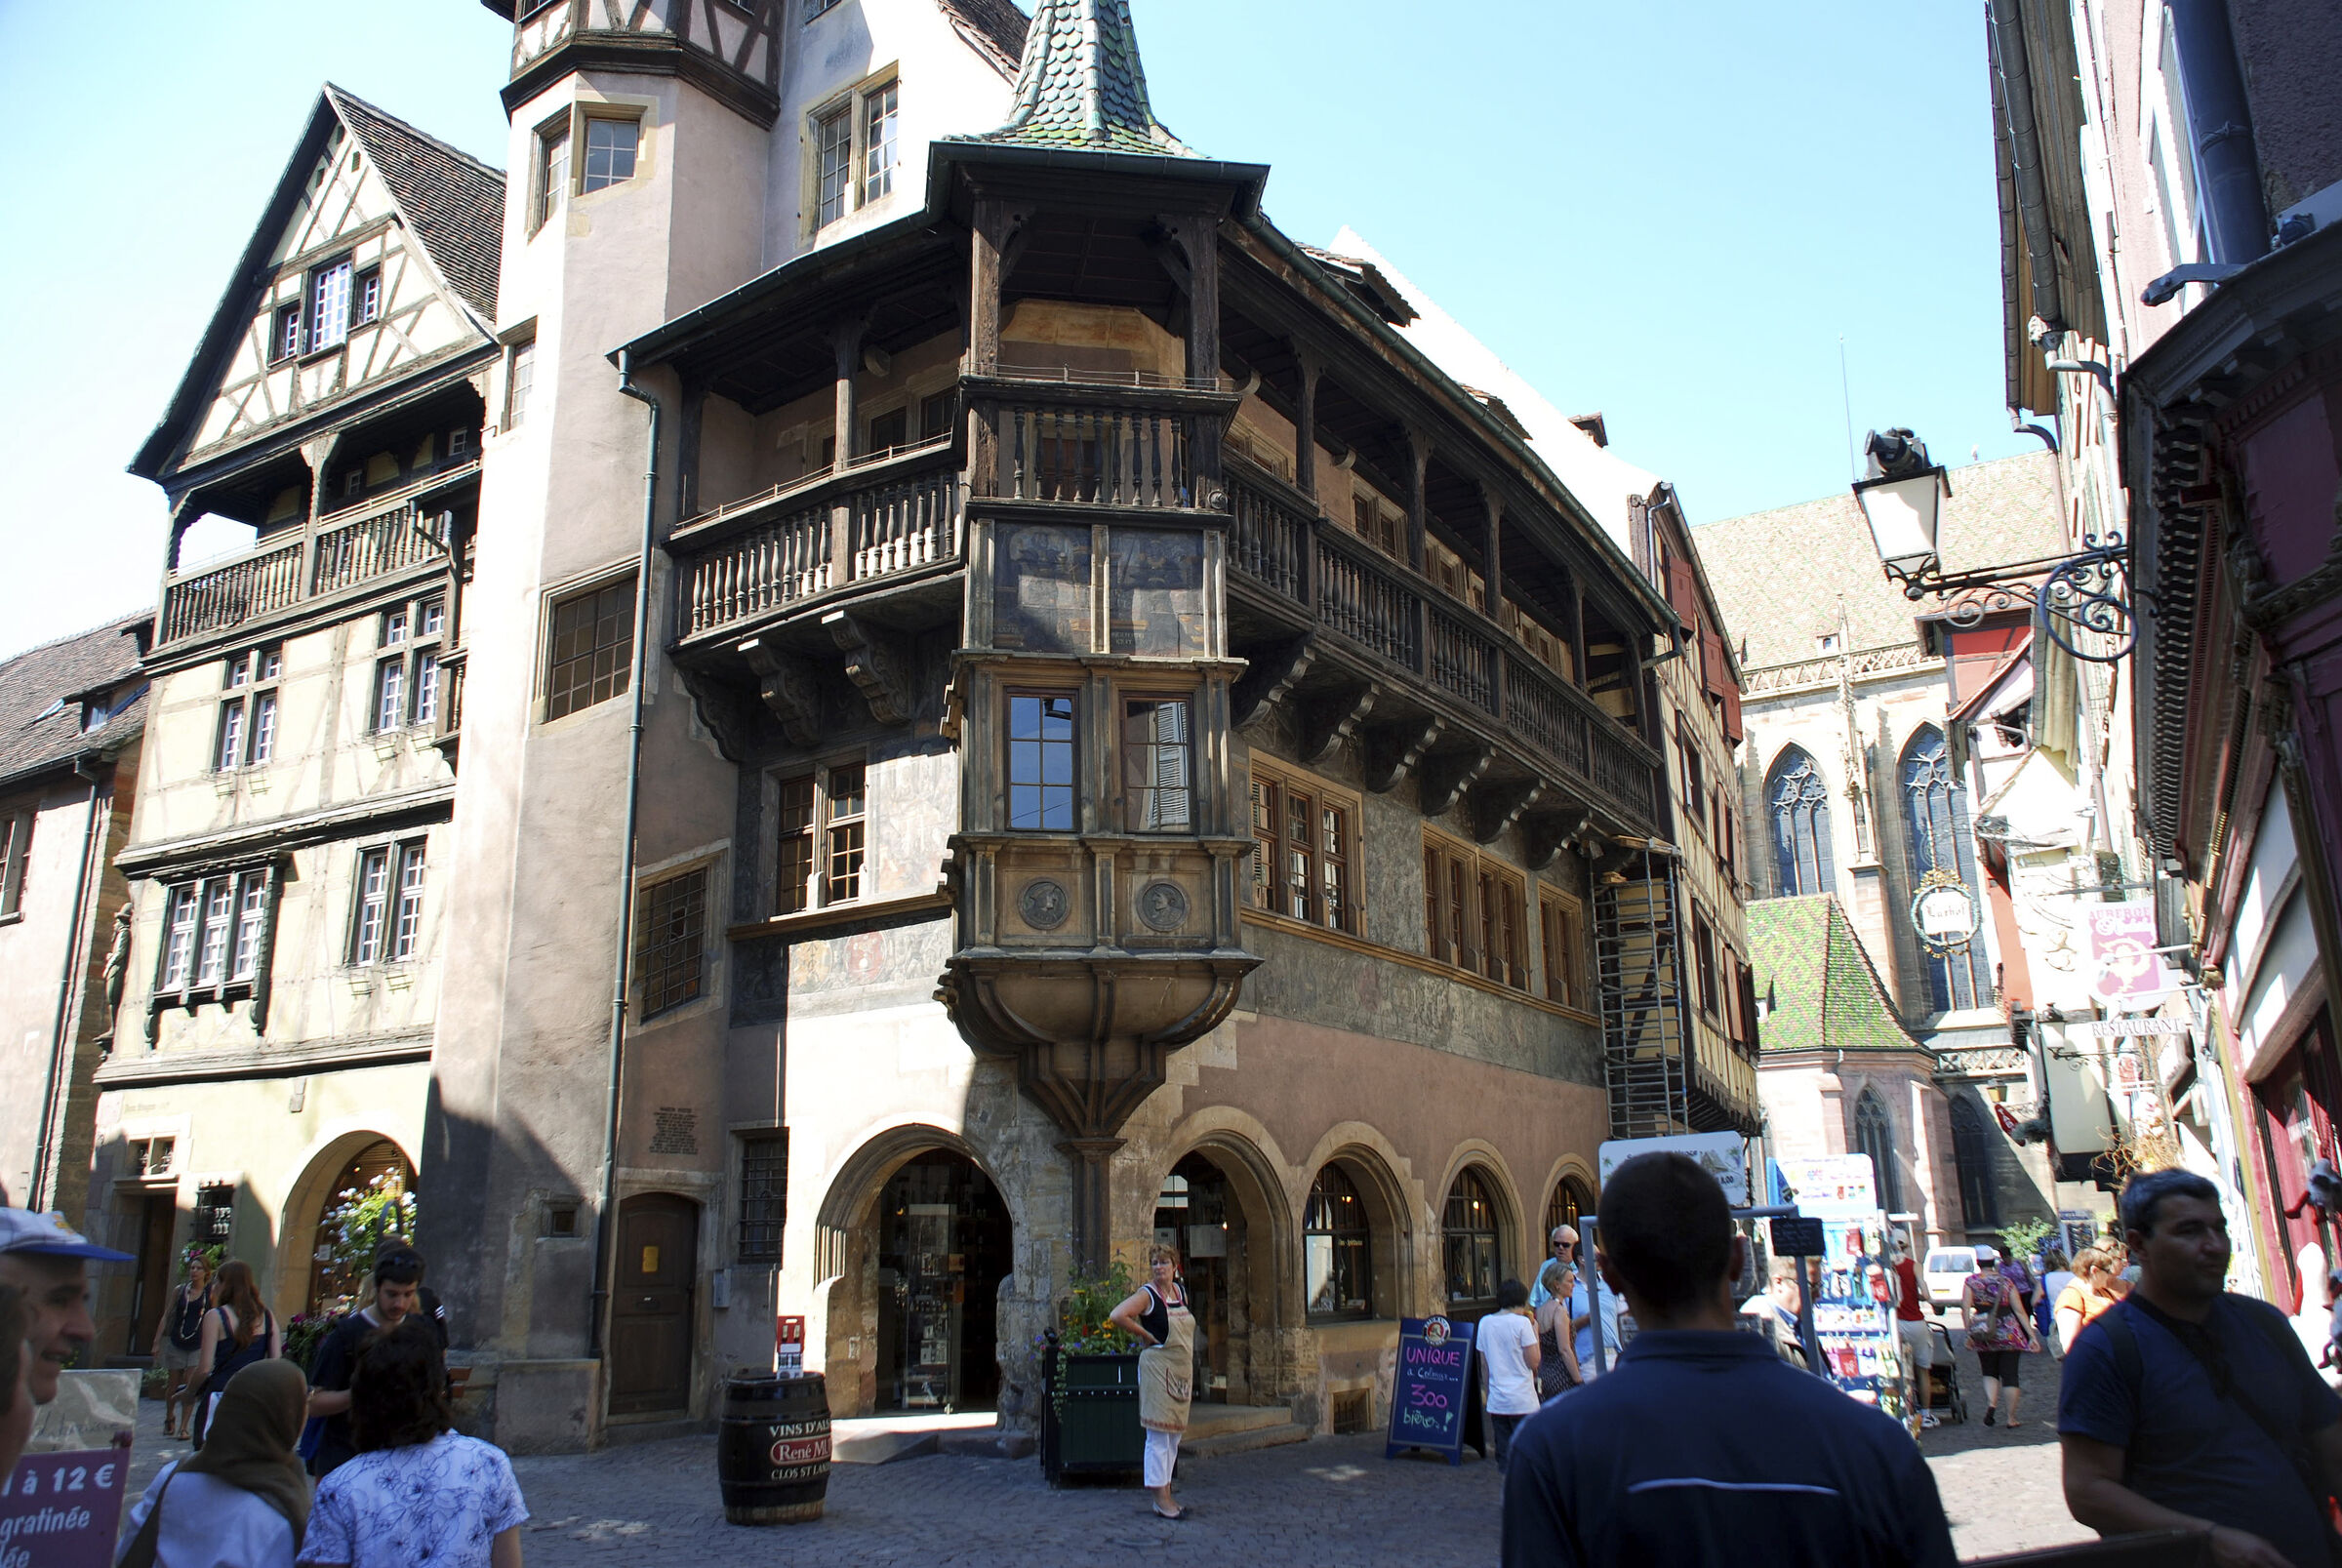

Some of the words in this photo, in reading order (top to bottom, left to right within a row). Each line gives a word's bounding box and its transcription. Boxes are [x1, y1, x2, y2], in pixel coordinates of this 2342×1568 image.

[2091, 1017, 2181, 1038] RESTAURANT
[1411, 1384, 1448, 1409] 300
[769, 1424, 802, 1437] VINS
[779, 1444, 812, 1462] René
[21, 1468, 38, 1496] à
[53, 1466, 88, 1493] 12
[94, 1464, 115, 1489] €
[771, 1467, 798, 1480] CLOS
[800, 1466, 812, 1477] ST
[0, 1506, 91, 1545] gratinée
